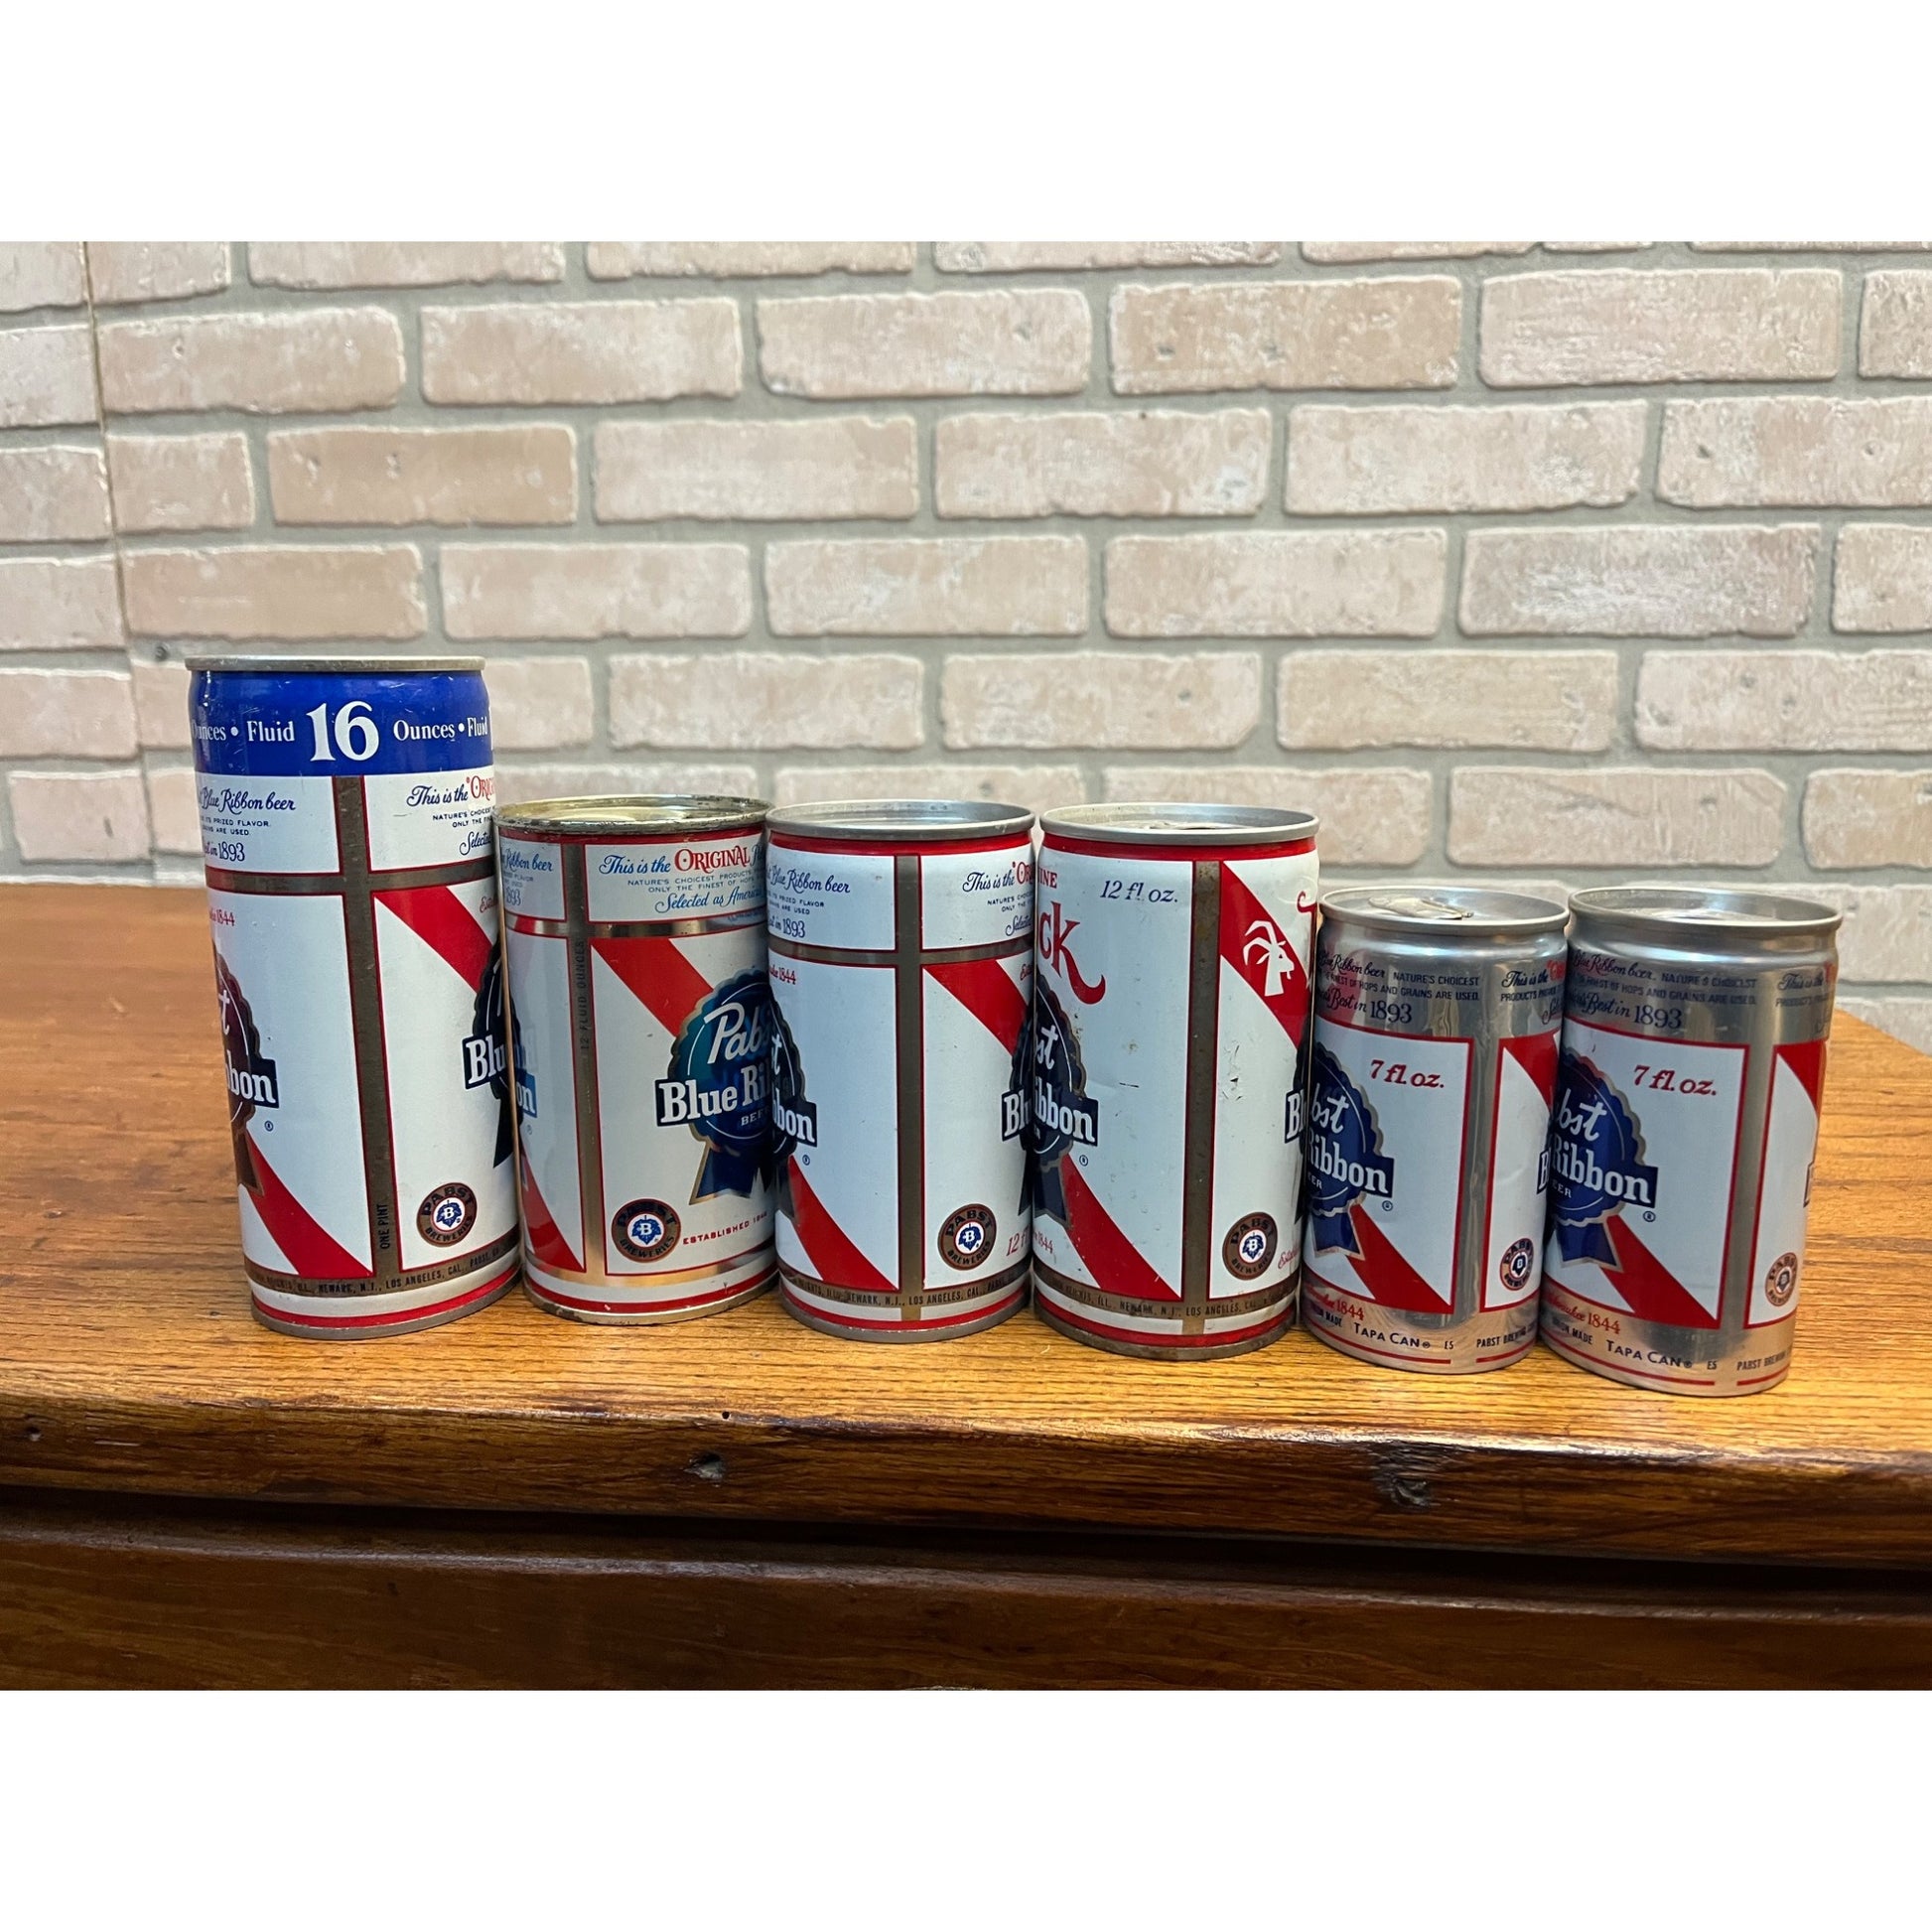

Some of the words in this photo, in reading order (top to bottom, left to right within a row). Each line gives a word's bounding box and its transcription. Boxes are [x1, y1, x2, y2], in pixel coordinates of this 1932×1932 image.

[246, 720, 295, 742] Fluid
[306, 700, 379, 762] 16
[393, 720, 455, 742] Ounces
[467, 716, 487, 737] Fluid
[218, 788, 263, 814] Ribbon
[265, 791, 296, 810] beer
[406, 785, 440, 806] This
[443, 788, 452, 803] is
[455, 784, 469, 801] the
[218, 842, 245, 862] 1893
[532, 853, 553, 872] beer
[599, 855, 633, 874] This
[637, 860, 647, 874] is
[651, 856, 671, 873] the
[674, 846, 751, 874] ORIGINAL
[720, 871, 751, 880] PRODUCTS
[783, 869, 822, 894] Ribbon
[825, 875, 851, 894] beer
[962, 872, 990, 892] This
[993, 875, 1000, 889] is
[1003, 870, 1015, 887] the
[655, 892, 708, 913] Selected
[713, 896, 724, 905] as
[799, 898, 824, 907] FLAVOR
[1100, 881, 1123, 899] 12
[1149, 889, 1178, 902] oz.
[782, 917, 805, 937] 1893
[575, 941, 587, 989] OUNCES
[1330, 954, 1362, 975] Ribbon
[1364, 962, 1385, 978] beer
[1393, 972, 1435, 984] NATURE'S
[1439, 976, 1480, 986] CHOICEST
[1587, 954, 1626, 976] Ribbon
[1501, 970, 1528, 988] This
[1529, 973, 1536, 985] is
[1359, 981, 1378, 992] HOPS
[1381, 985, 1398, 995] AND
[1401, 987, 1433, 999] GRAINS
[1436, 991, 1451, 1000] ARE
[1501, 990, 1537, 1001] PRODUCTS
[1709, 994, 1727, 1004] ARE
[578, 996, 589, 1031] FLUID
[1326, 988, 1355, 1011] Best
[1370, 1000, 1412, 1024] 1893
[1582, 993, 1615, 1015] Best
[1615, 1000, 1630, 1017] in
[1633, 1004, 1682, 1029] 1893
[580, 1037, 590, 1050] 12
[1371, 1059, 1384, 1079] 7
[1411, 1073, 1445, 1088] oz.
[1634, 1064, 1648, 1086] 7
[1650, 1069, 1674, 1091] fl.
[1680, 1078, 1717, 1096] oz.
[658, 1079, 738, 1124] Blue
[1311, 1082, 1349, 1133] bst
[1559, 1087, 1607, 1141] bst
[422, 1186, 475, 1216] PABST
[378, 1204, 389, 1225] PINT
[945, 1210, 992, 1237] PABST
[379, 1228, 390, 1250] ONE
[683, 1221, 750, 1245] ESTABLISHED
[1007, 1233, 1019, 1256] 12
[386, 1279, 402, 1289] LOS
[405, 1270, 445, 1285] ANGELES,
[908, 1296, 923, 1306] LOS
[927, 1292, 964, 1304] ANGELES,
[1185, 1307, 1201, 1316] LOS
[1205, 1303, 1242, 1314] ANGELES,
[1336, 1300, 1364, 1321] 1844
[1588, 1312, 1620, 1334] 1844
[1353, 1322, 1386, 1341] TAPA
[1476, 1336, 1500, 1348] PABST
[1573, 1329, 1592, 1344] MADE
[1605, 1340, 1642, 1360] TAPA
[1707, 1360, 1718, 1370] ES
[1736, 1359, 1761, 1371] PABST
